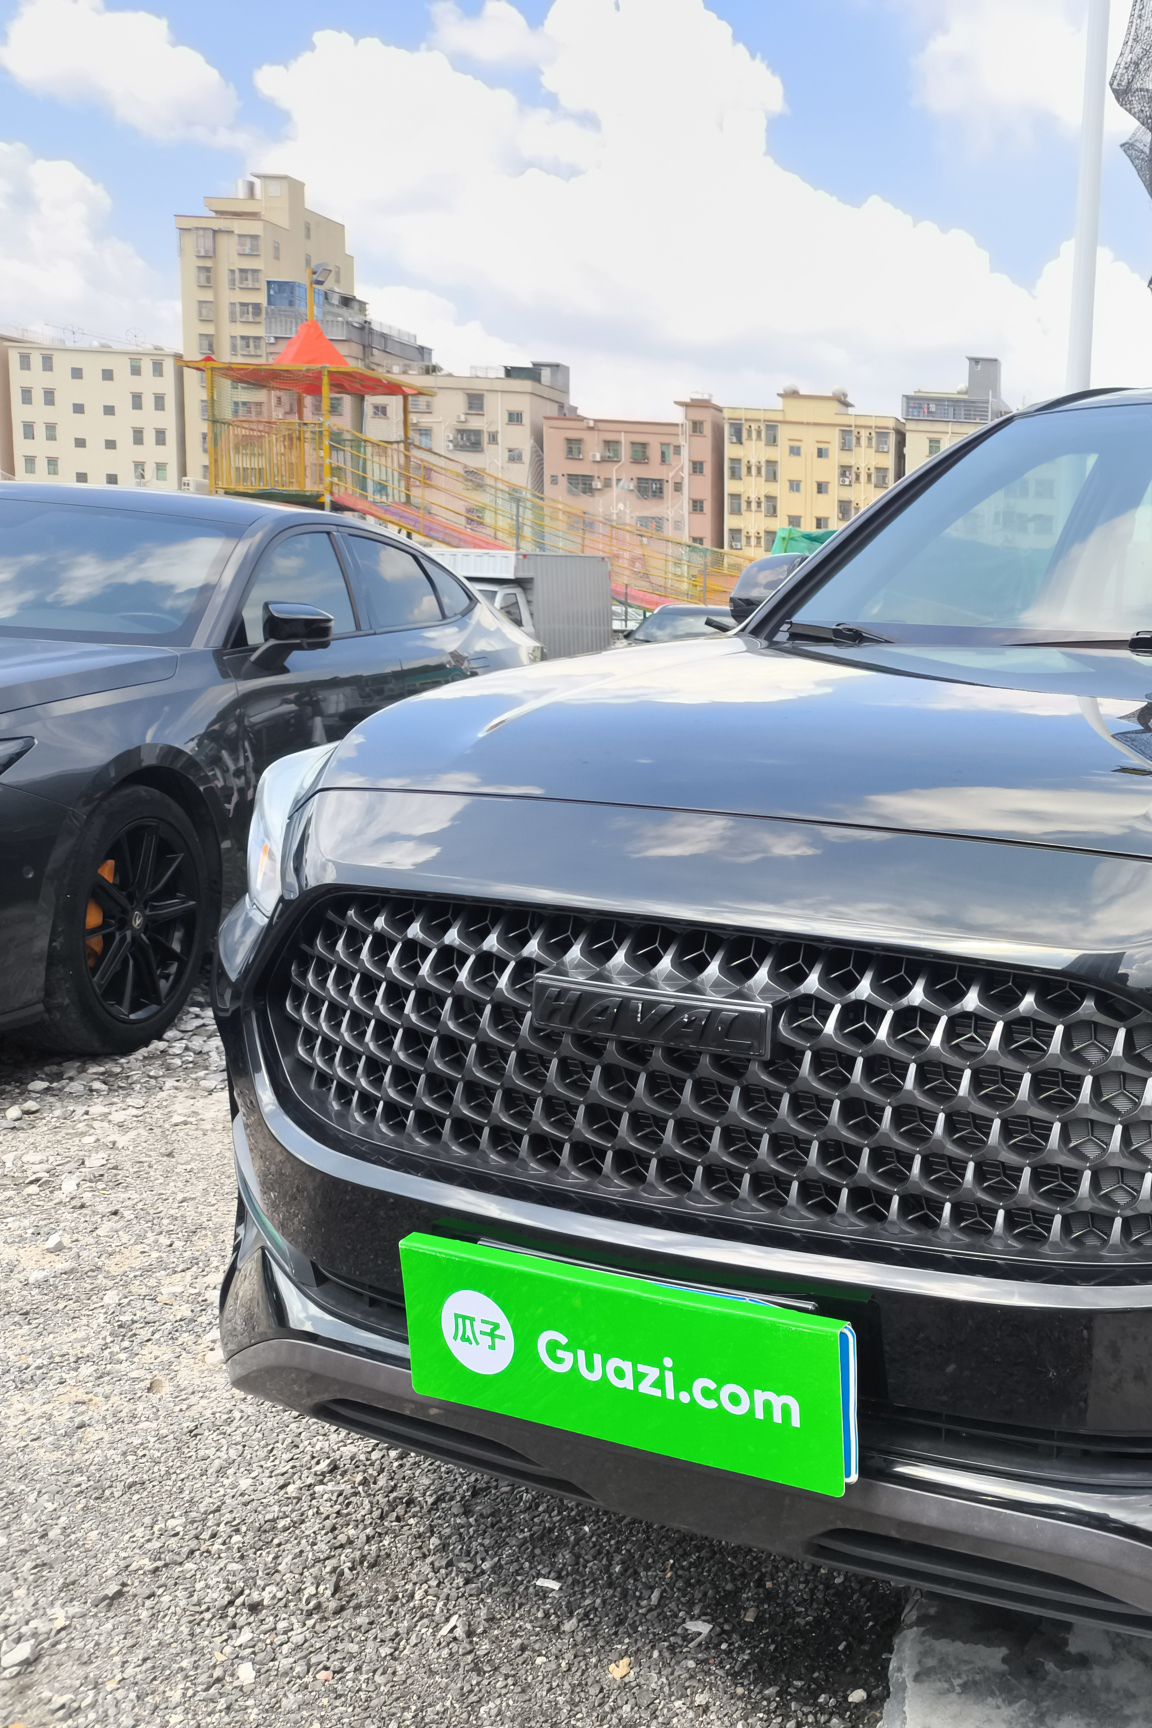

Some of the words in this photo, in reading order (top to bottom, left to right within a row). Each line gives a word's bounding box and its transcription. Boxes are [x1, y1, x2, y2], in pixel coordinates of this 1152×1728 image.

[537, 987, 753, 1048] HAVAL
[453, 1312, 506, 1350] 瓜子
[537, 1329, 801, 1428] Guazi.com
